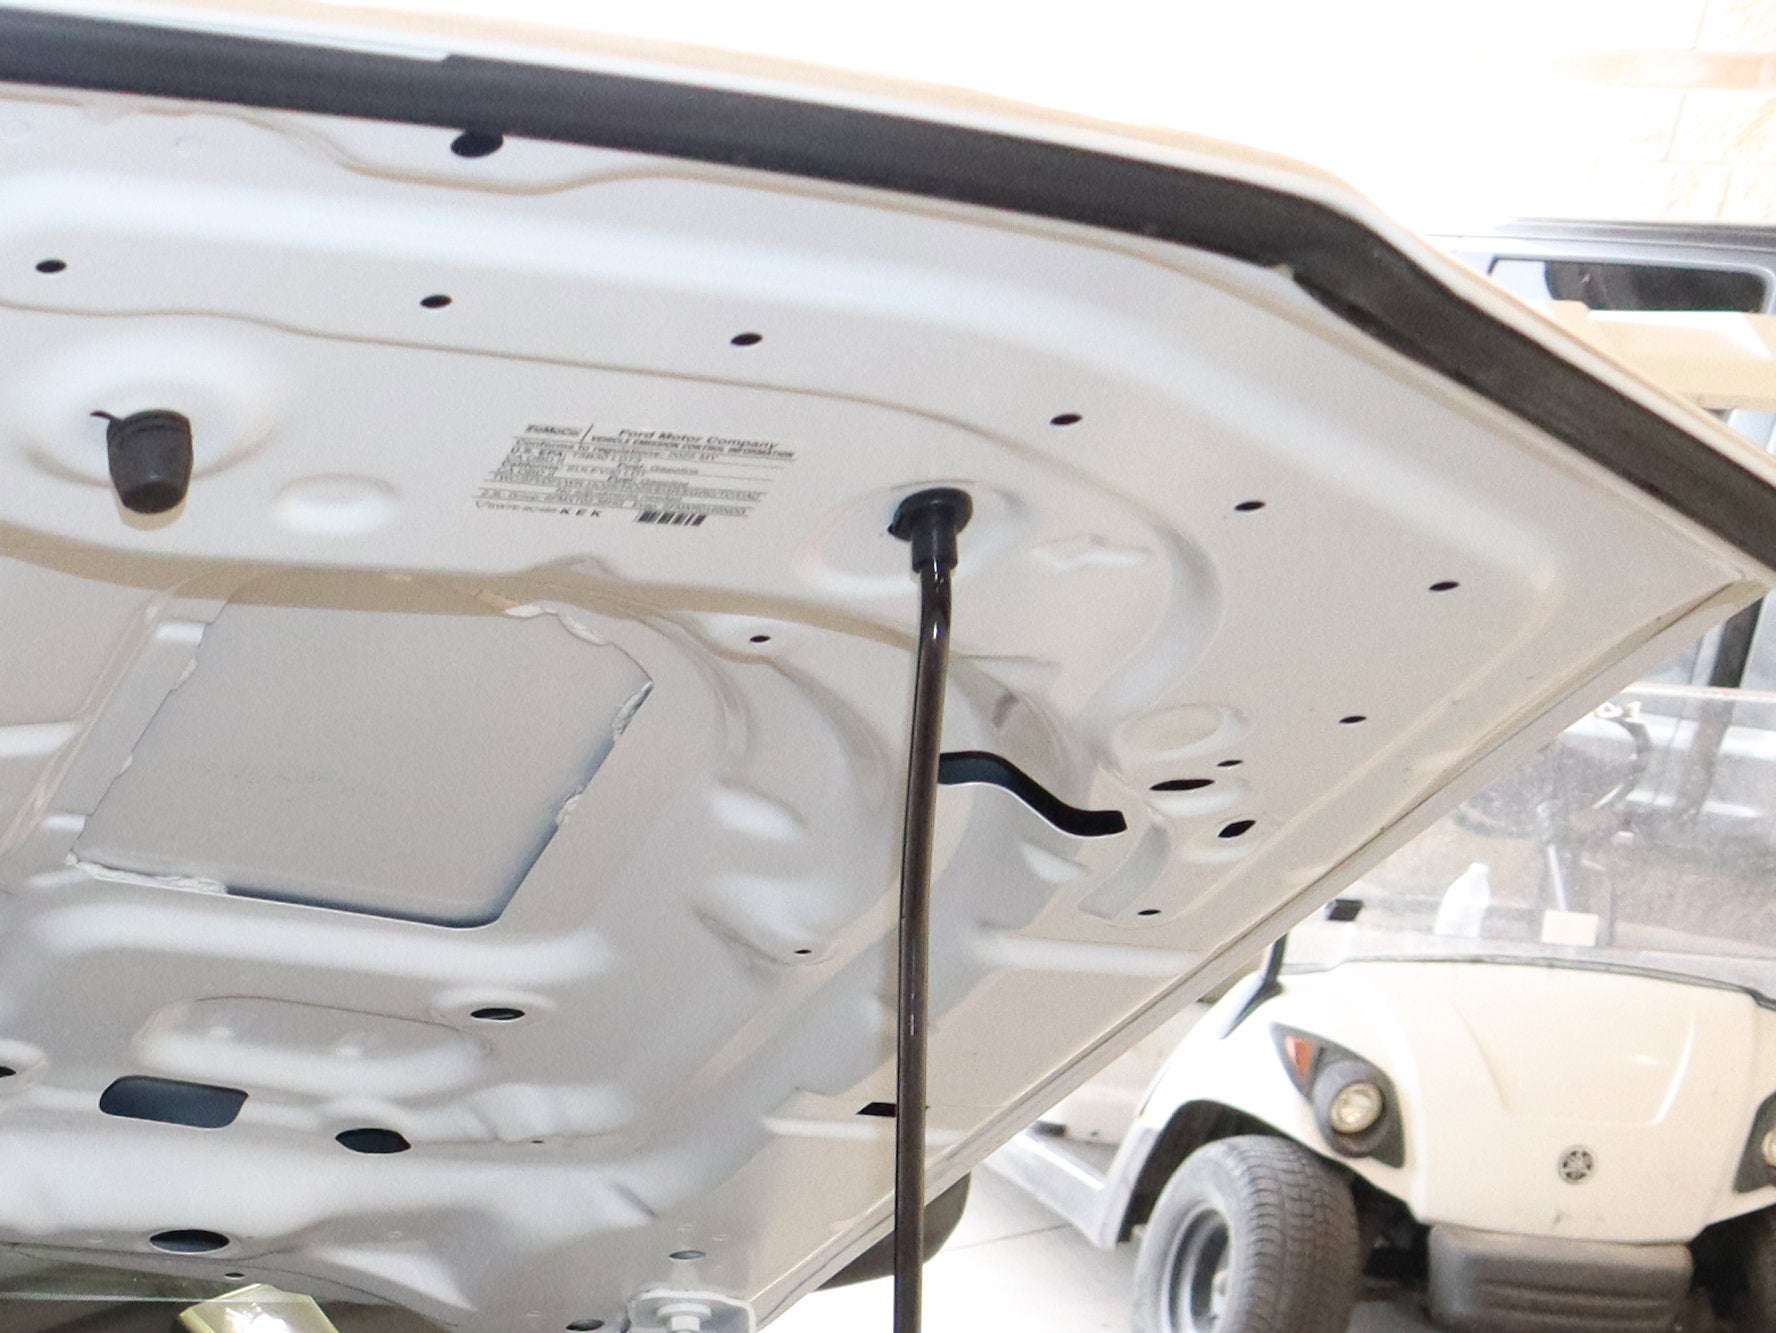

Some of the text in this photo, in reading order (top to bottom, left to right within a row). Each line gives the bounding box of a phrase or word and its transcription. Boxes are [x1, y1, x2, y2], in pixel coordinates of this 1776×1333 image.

[618, 428, 779, 450] Ford Motor Company
[632, 439, 680, 449] EMISSION
[682, 443, 724, 452] CONTROL
[727, 446, 796, 459] INFORMATION
